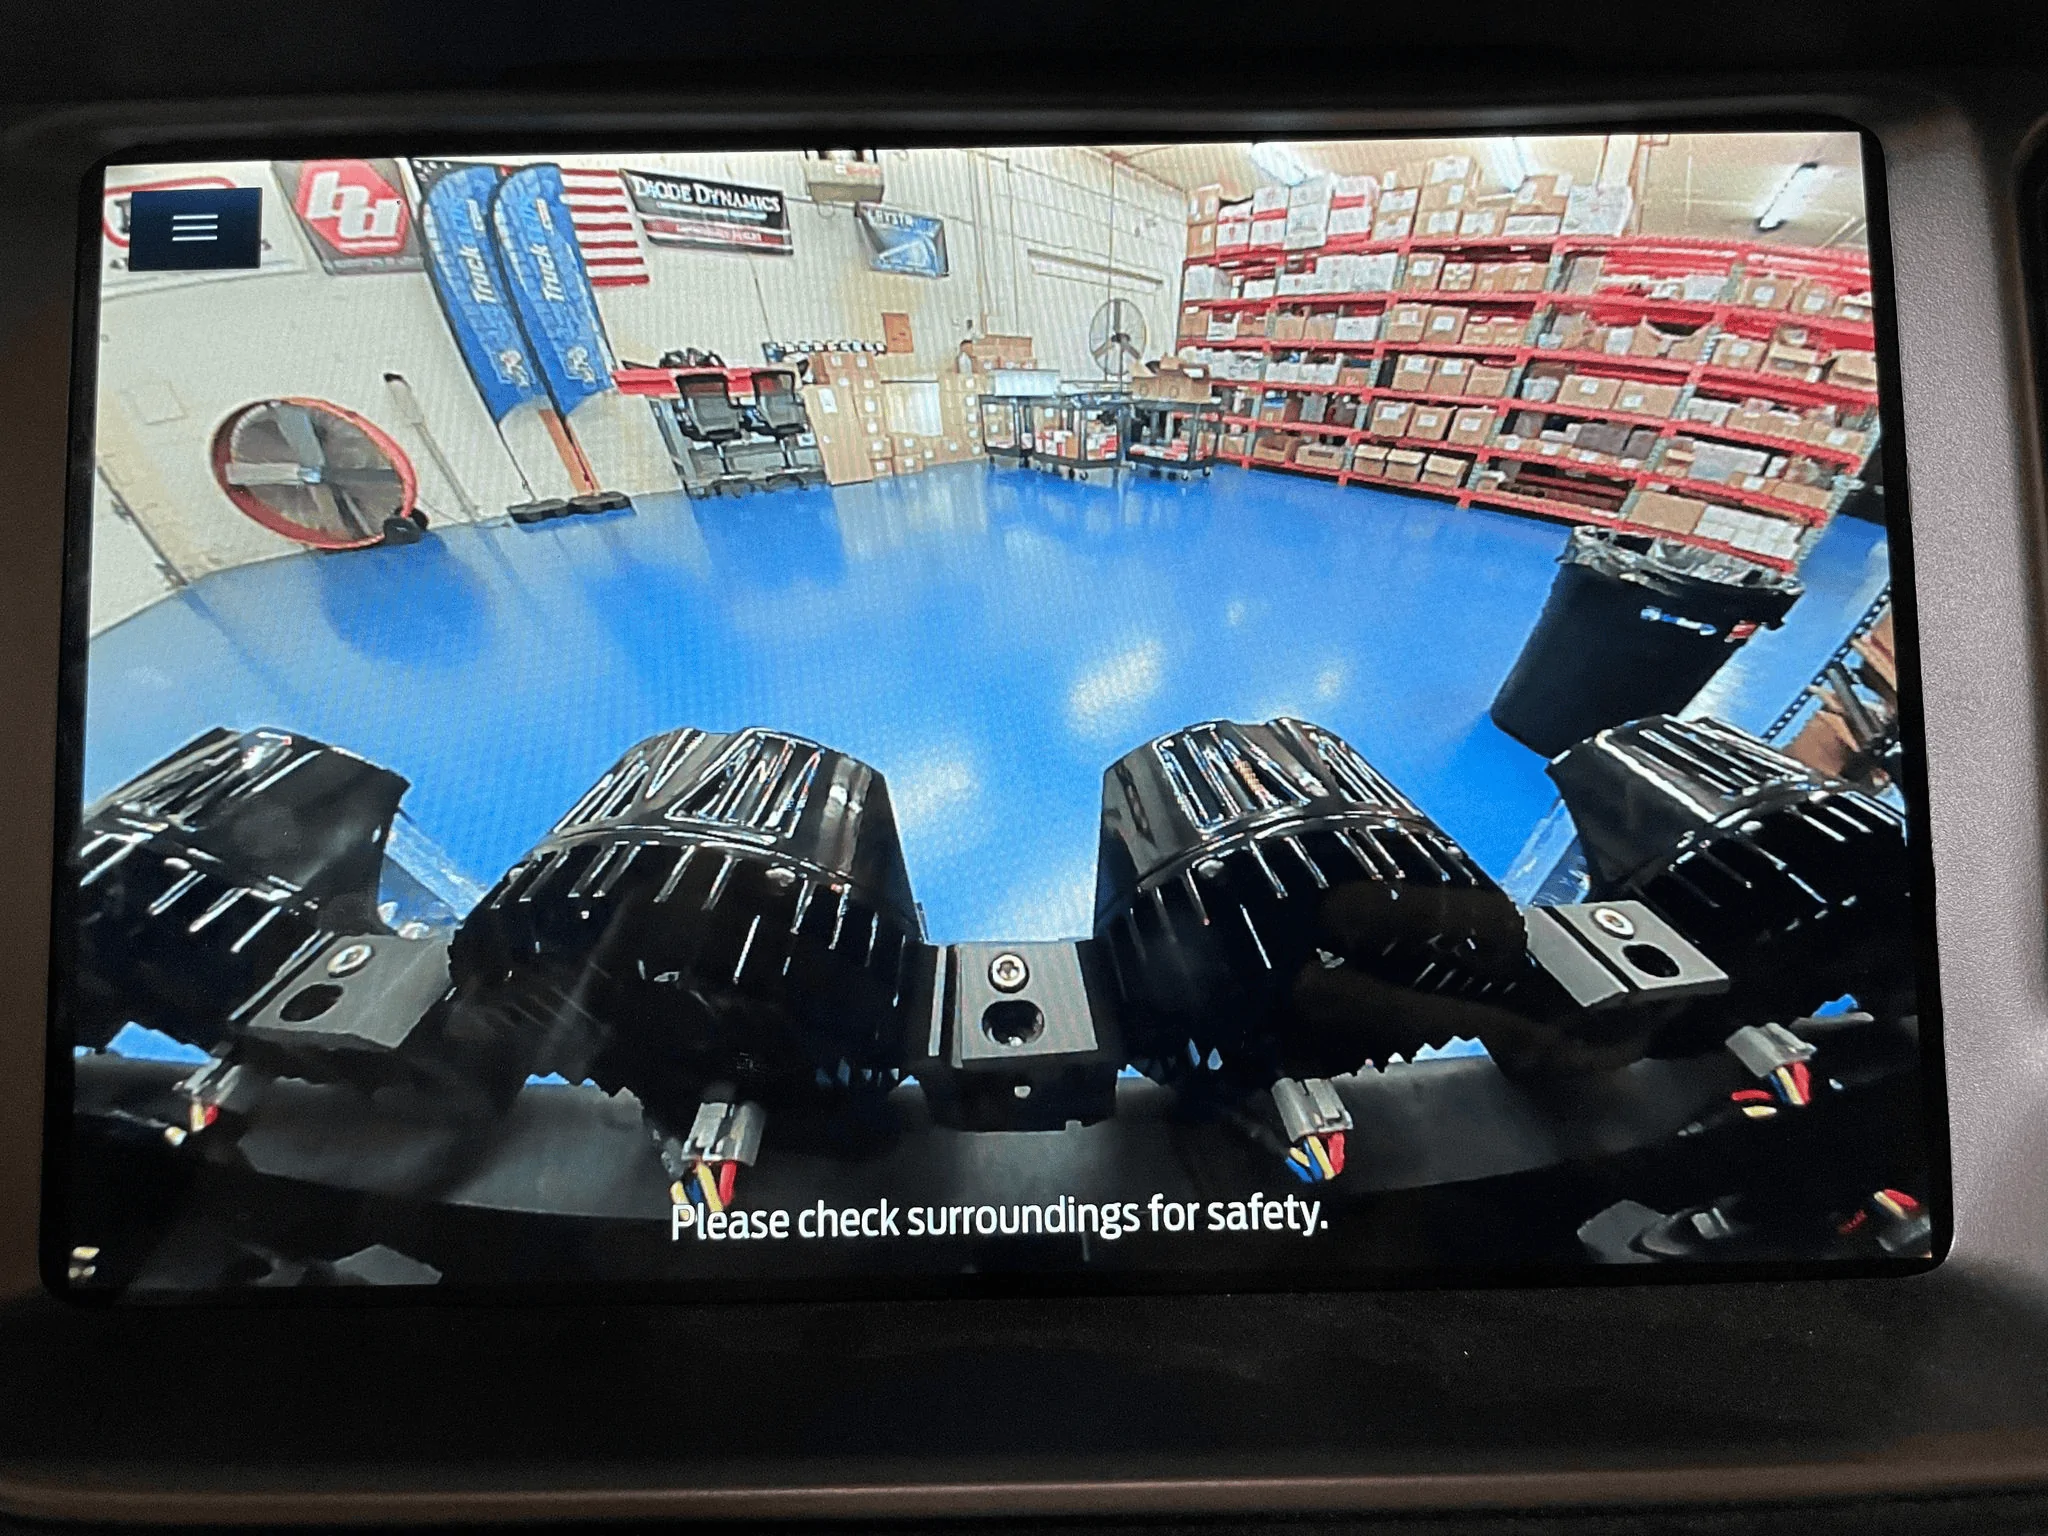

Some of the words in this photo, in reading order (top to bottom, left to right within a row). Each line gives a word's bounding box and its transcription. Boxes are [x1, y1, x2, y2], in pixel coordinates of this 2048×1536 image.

[693, 182, 781, 212] DYNAMICS
[459, 244, 498, 304] Truck
[530, 243, 565, 303] Truck
[671, 1202, 790, 1241] Please
[798, 1198, 900, 1238] check
[907, 1195, 1141, 1240] surroundings
[1148, 1193, 1200, 1232] for
[1207, 1192, 1329, 1237] safety.
